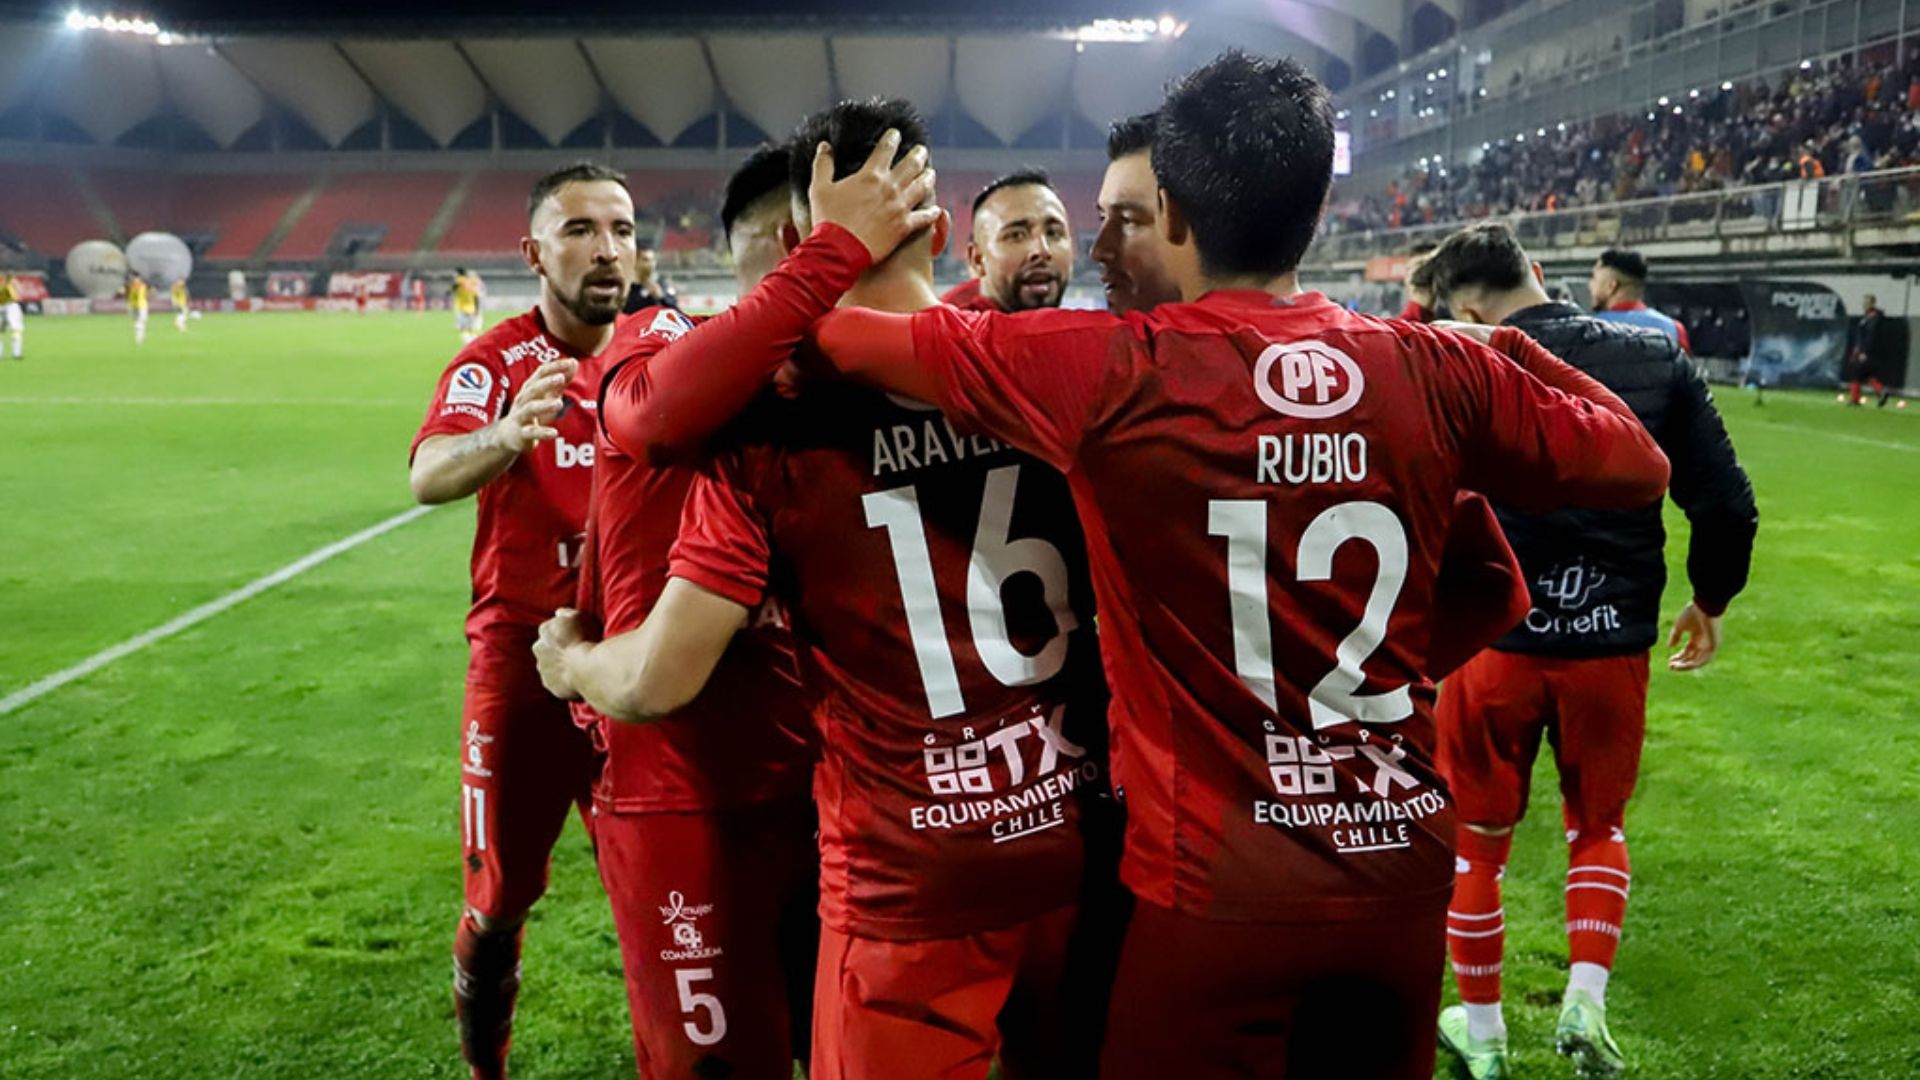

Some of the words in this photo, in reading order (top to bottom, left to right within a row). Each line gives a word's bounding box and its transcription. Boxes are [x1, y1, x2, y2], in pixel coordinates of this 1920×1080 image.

[1280, 351, 1340, 403] PF
[1256, 432, 1368, 484] RUBIO
[861, 464, 1079, 720] 16
[1208, 499, 1414, 731] 12
[1525, 604, 1621, 634] Onefit
[462, 783, 487, 850] 11
[991, 802, 1064, 838] CHILE
[1332, 824, 1409, 847] CHILE
[674, 967, 727, 1046] 5
